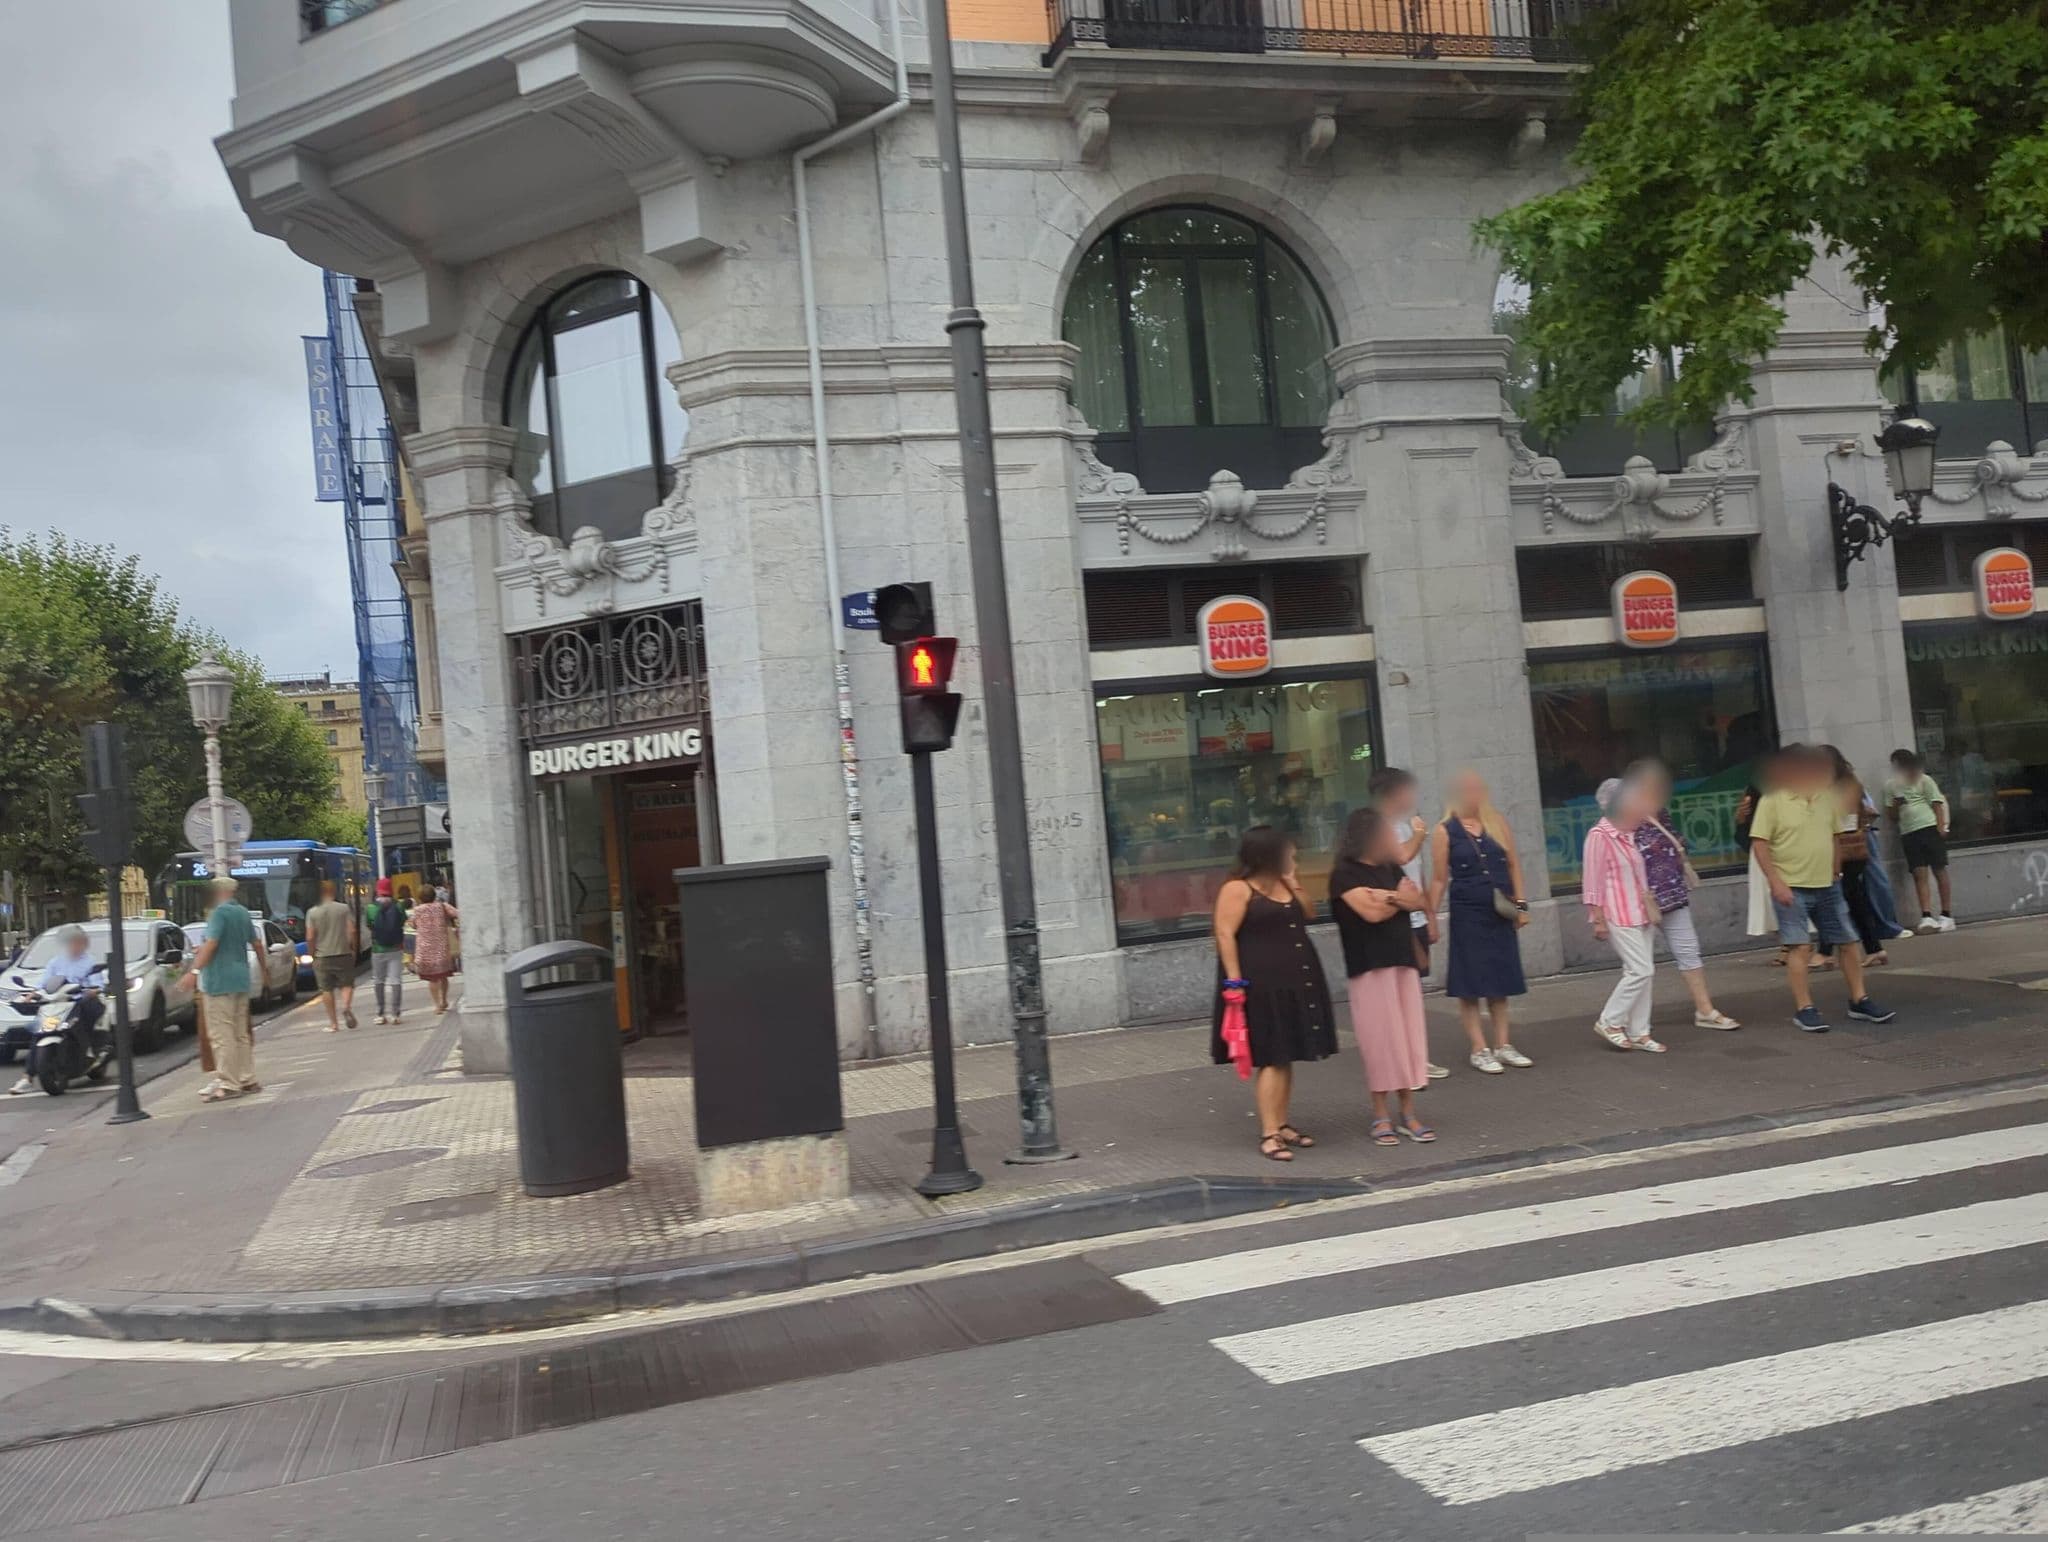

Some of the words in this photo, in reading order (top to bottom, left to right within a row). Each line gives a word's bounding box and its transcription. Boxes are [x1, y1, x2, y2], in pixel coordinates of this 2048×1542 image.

[311, 342, 338, 492] ISTRATE
[1986, 571, 2030, 586] BURGER
[1987, 584, 2032, 604] KING
[1623, 597, 1674, 612] BURGER
[1624, 610, 1676, 630] KING
[1208, 623, 1265, 640] BURGER
[1209, 636, 1268, 660] KING
[1905, 635, 1998, 662] URGER
[2000, 629, 2048, 656] KIN
[529, 738, 631, 776] BURGER
[633, 728, 702, 763] KING
